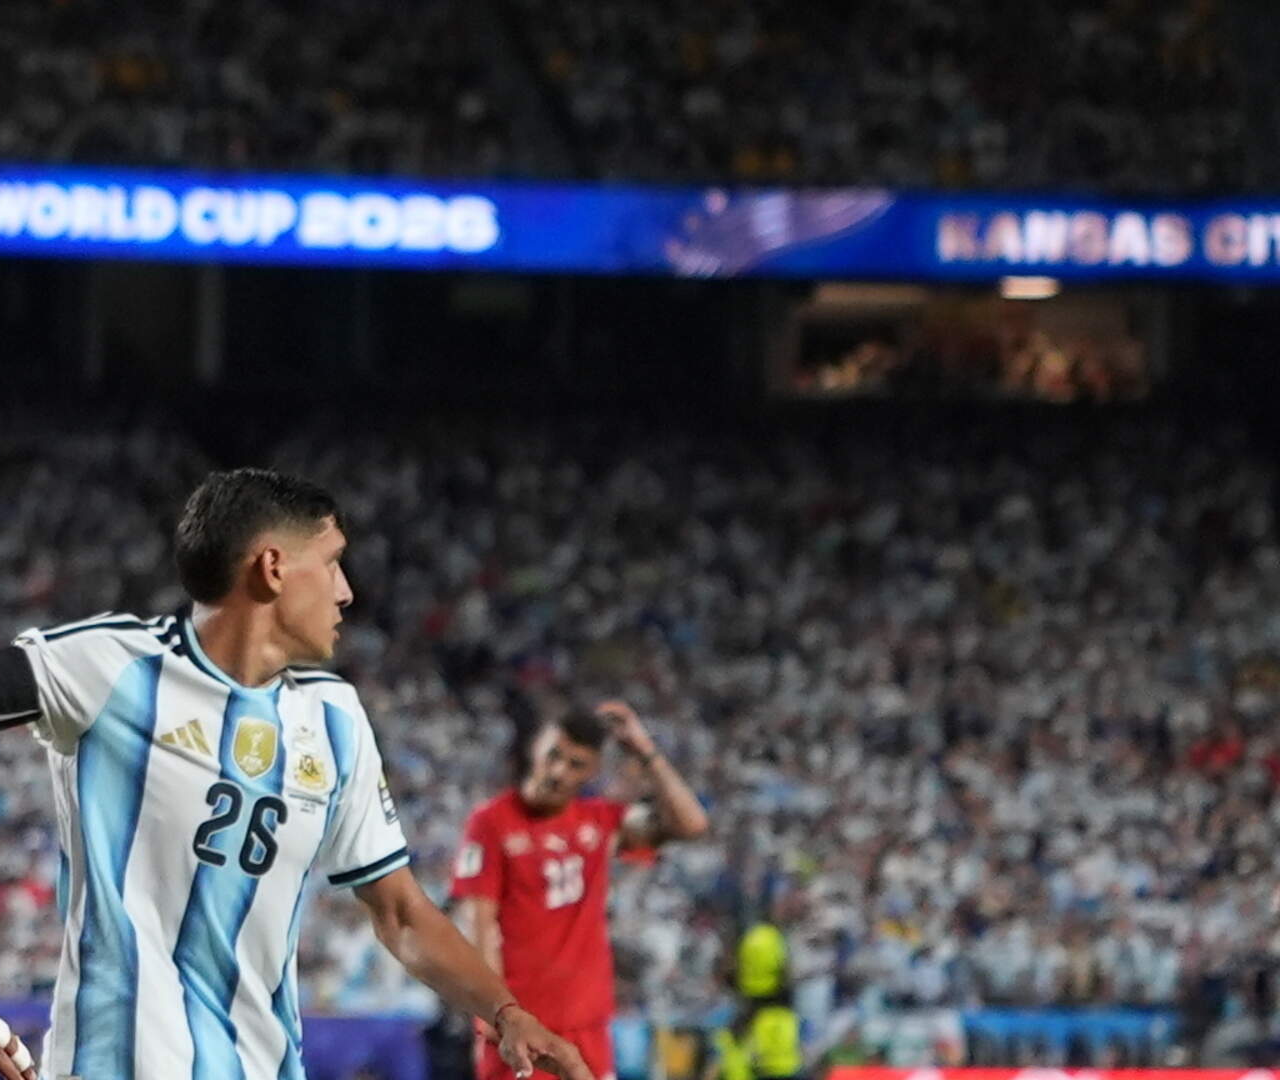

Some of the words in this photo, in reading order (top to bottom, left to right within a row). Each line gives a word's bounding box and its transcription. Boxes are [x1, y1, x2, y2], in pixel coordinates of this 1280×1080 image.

[179, 188, 297, 247] CUP
[297, 191, 502, 254] 2026
[936, 208, 1194, 266] KANSAS
[192, 781, 288, 876] 26
